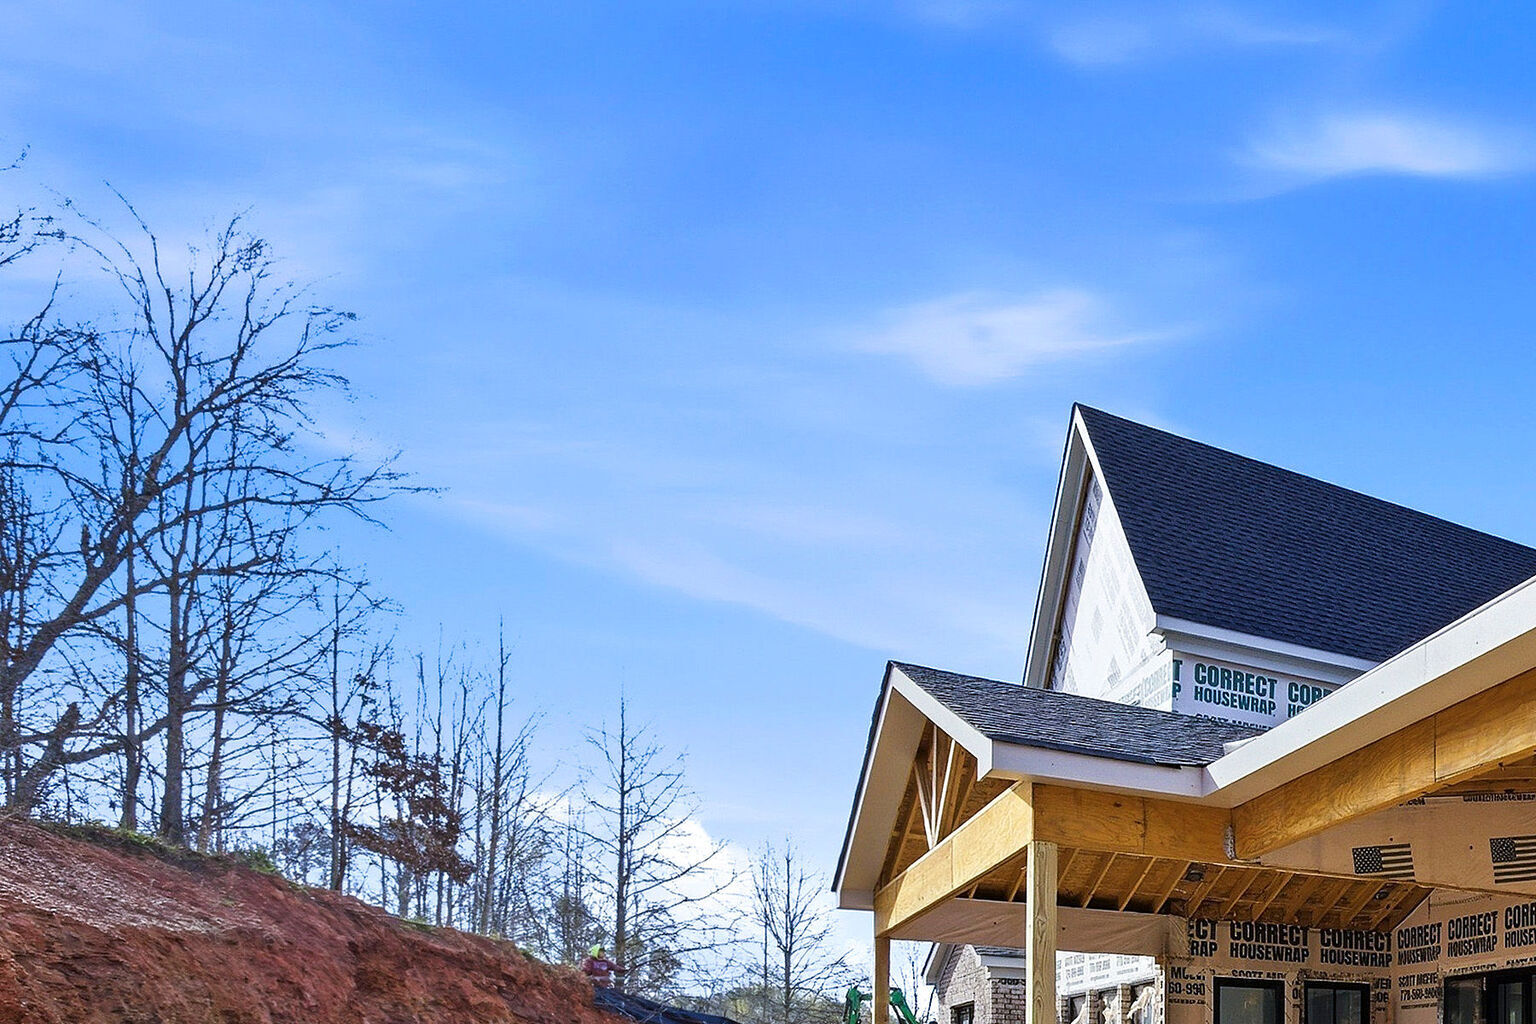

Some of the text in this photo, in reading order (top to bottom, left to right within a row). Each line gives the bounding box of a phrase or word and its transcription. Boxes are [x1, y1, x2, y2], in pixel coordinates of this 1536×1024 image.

[1194, 662, 1278, 699] CORRECT
[1194, 685, 1276, 716] HOUSEWRAP
[1229, 920, 1310, 947] CORRECT
[1398, 922, 1442, 949] CORRECT
[1448, 911, 1498, 940] CORRECT
[1229, 942, 1310, 963] HOUSEWRAP
[1320, 928, 1393, 951] CORRECT
[1320, 949, 1393, 968] HOUSEWRAP
